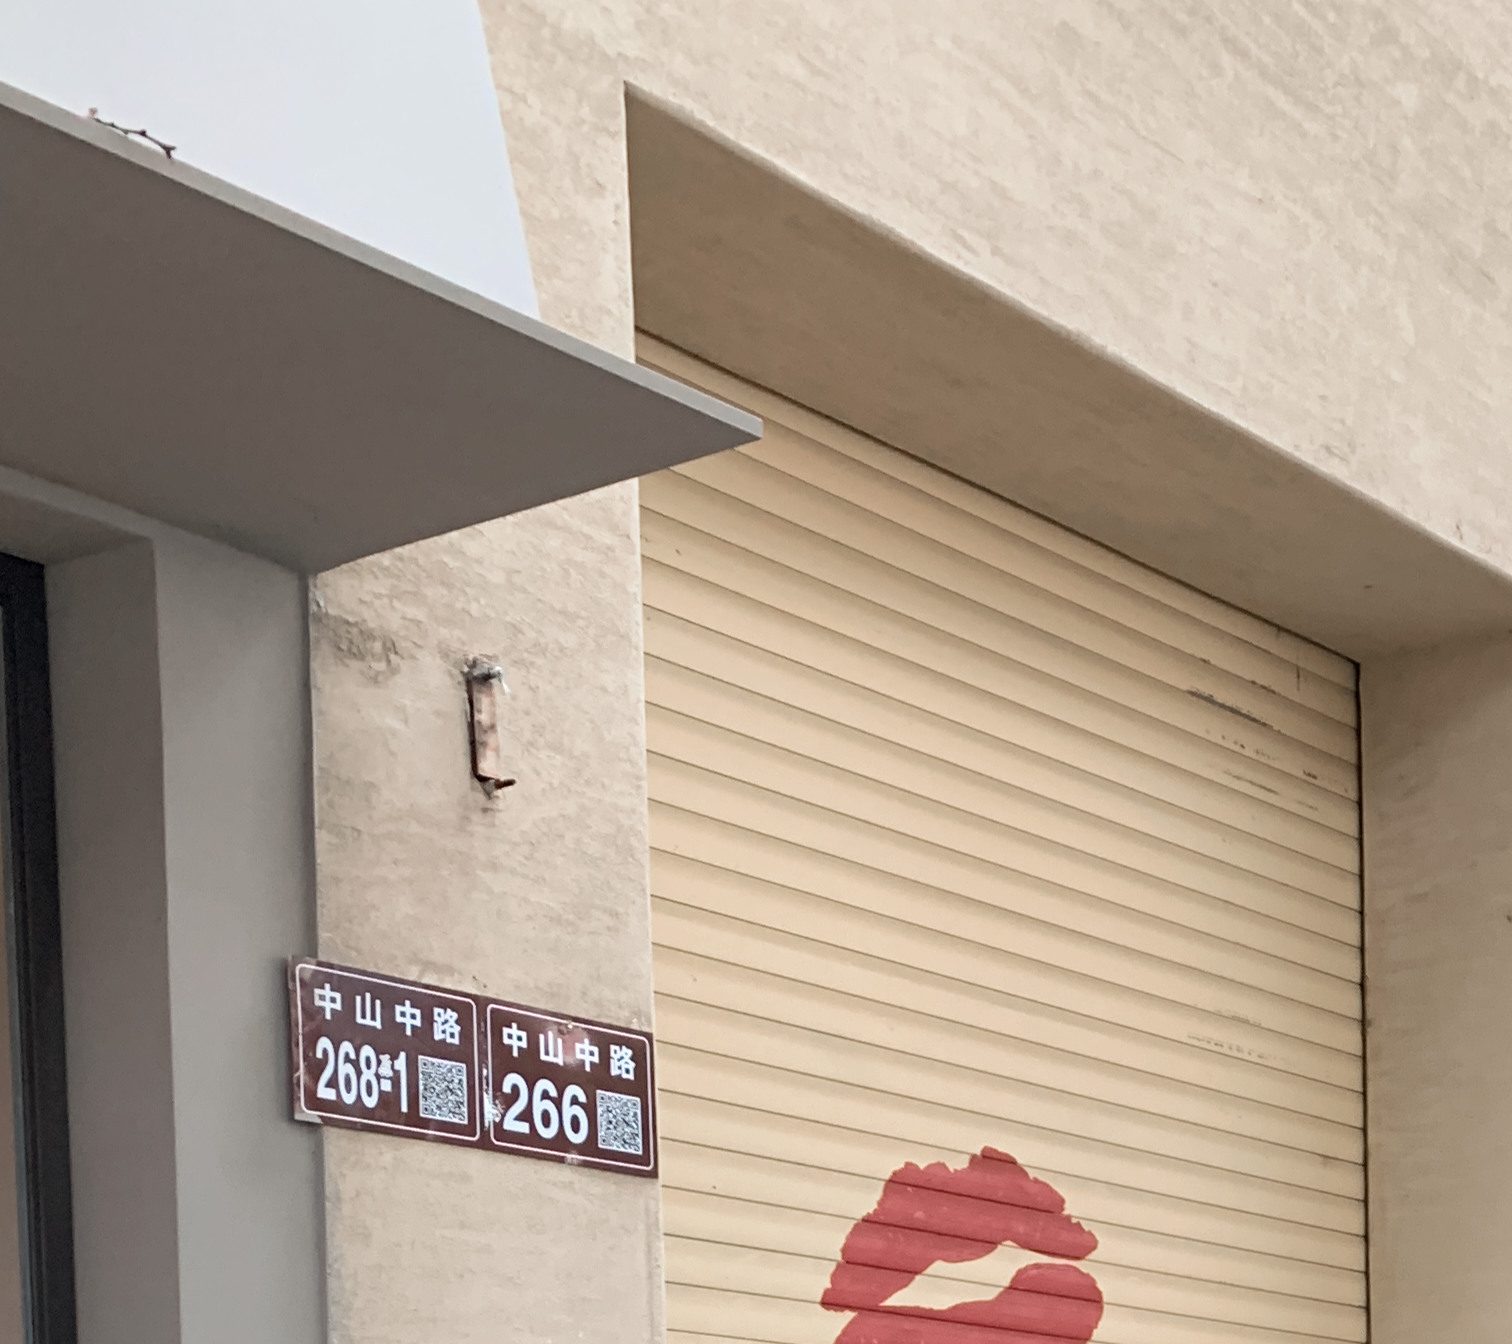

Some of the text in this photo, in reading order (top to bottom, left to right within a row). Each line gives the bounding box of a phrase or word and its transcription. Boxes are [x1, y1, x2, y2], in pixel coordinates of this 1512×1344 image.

[313, 982, 462, 1046] 中山中路
[502, 1022, 637, 1081] 中山中路
[502, 1073, 589, 1144] 266
